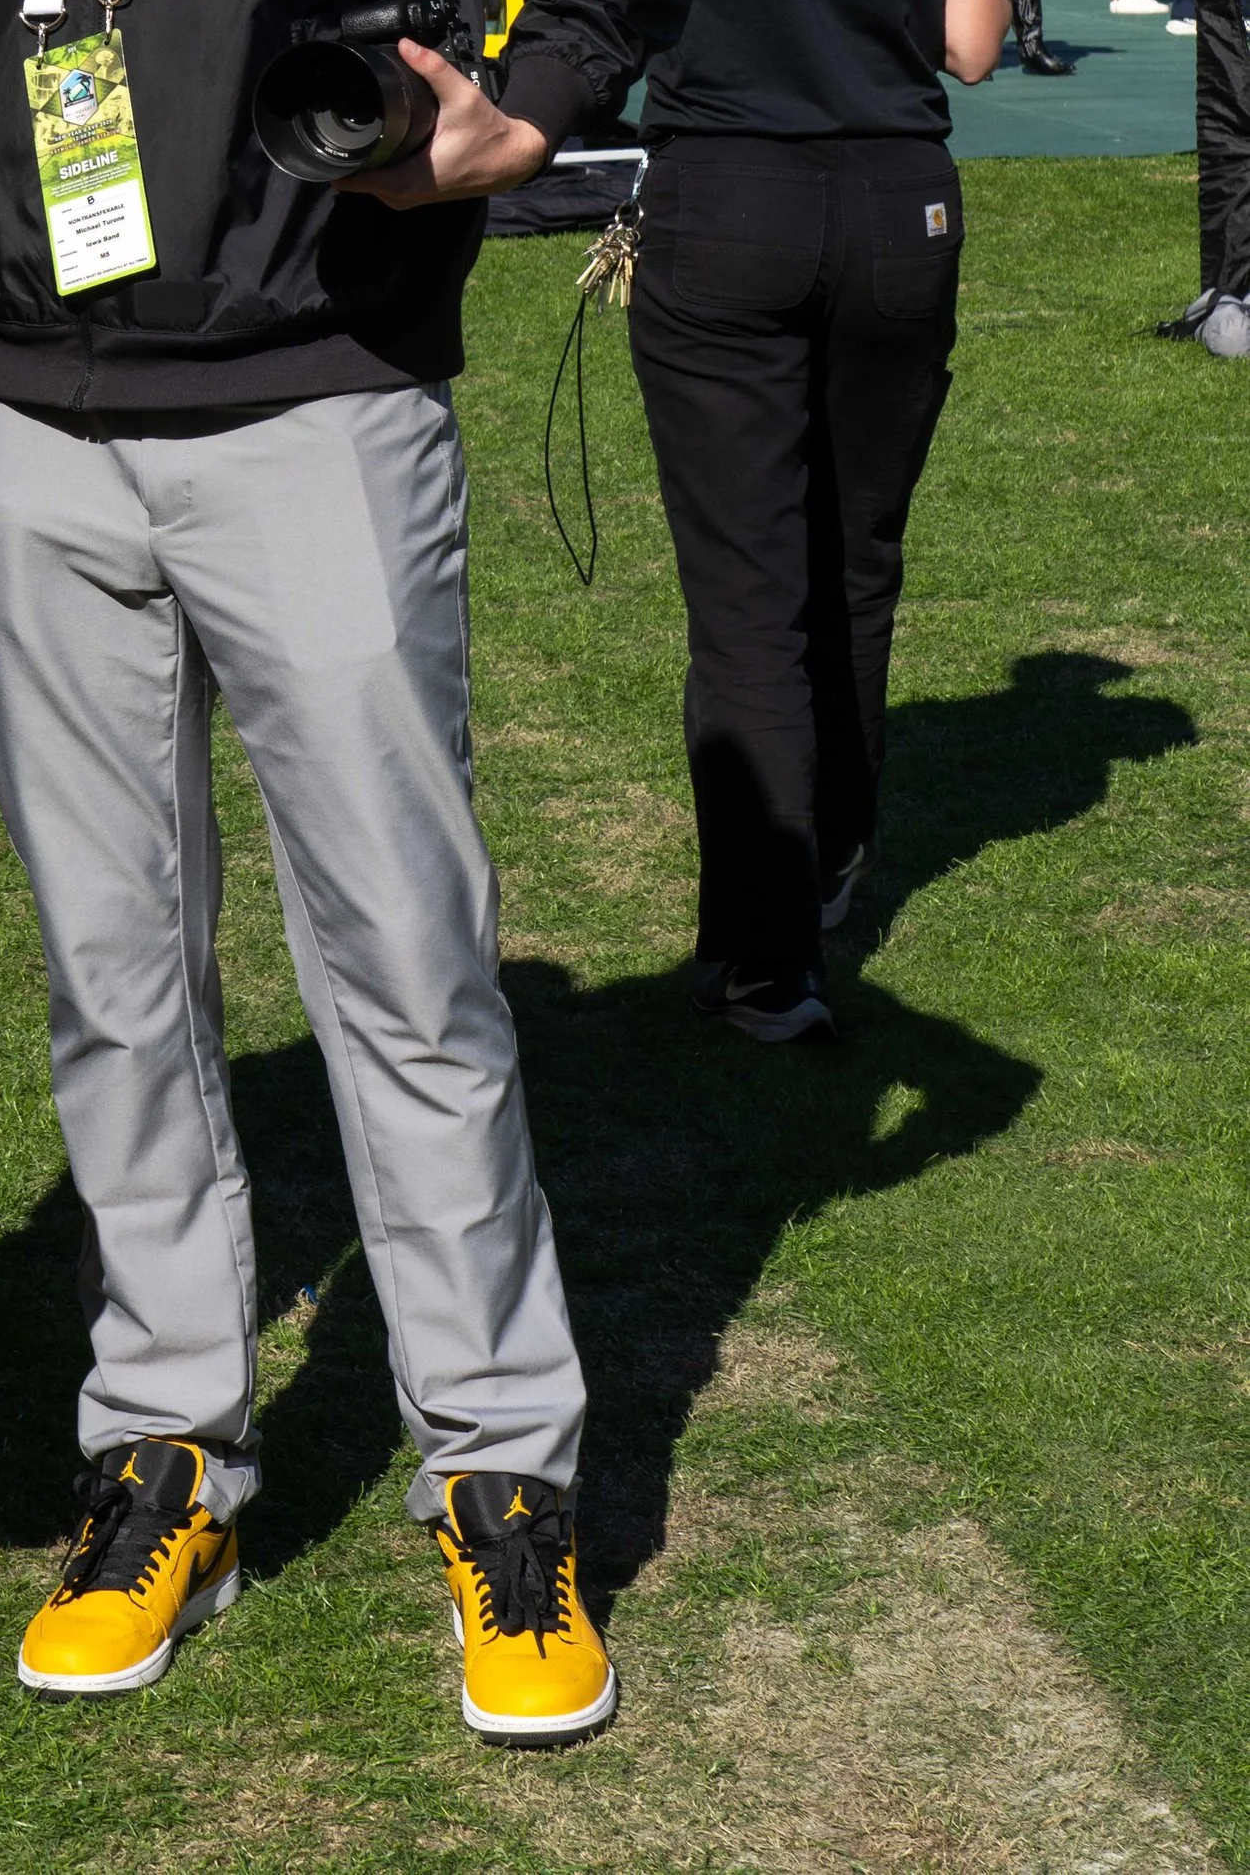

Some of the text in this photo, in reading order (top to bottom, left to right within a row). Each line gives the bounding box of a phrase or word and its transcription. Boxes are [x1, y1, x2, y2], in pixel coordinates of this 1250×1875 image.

[54, 134, 67, 142] NEW
[59, 150, 119, 180] SIDELINE
[68, 203, 125, 226] NON-TRANSFERABLE
[75, 215, 125, 235] Michael Turone
[85, 232, 120, 248] Iowa Band
